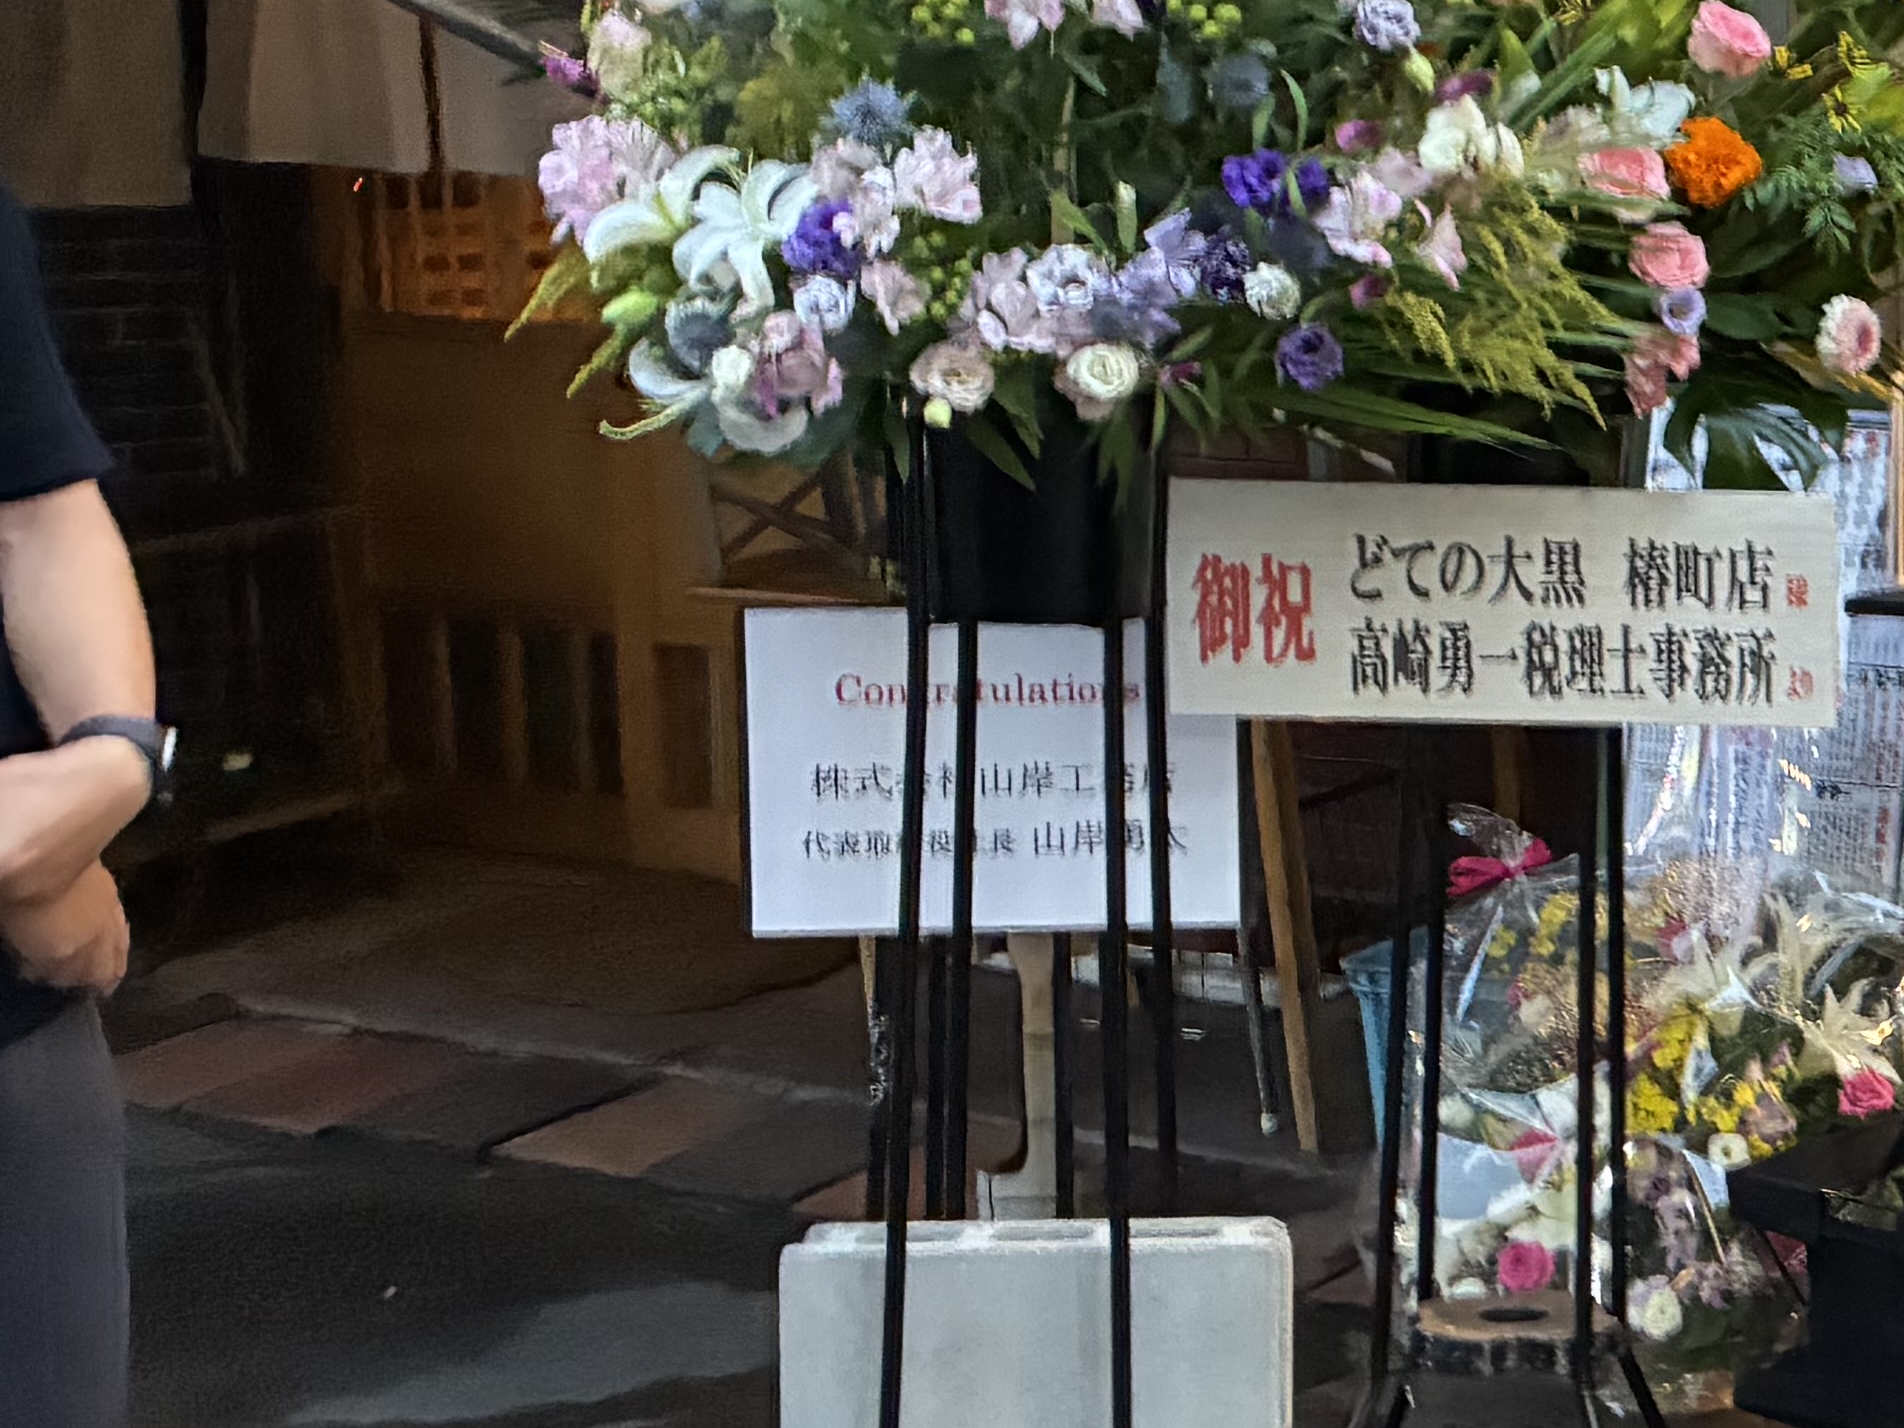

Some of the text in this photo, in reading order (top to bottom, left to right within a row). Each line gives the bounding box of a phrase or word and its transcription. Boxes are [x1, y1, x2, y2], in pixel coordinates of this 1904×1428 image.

[1190, 550, 1318, 668] 御祝
[1348, 532, 1588, 608] どての大黒
[1620, 536, 1778, 612] 椿町店
[834, 672, 1142, 708] Conrtulatios
